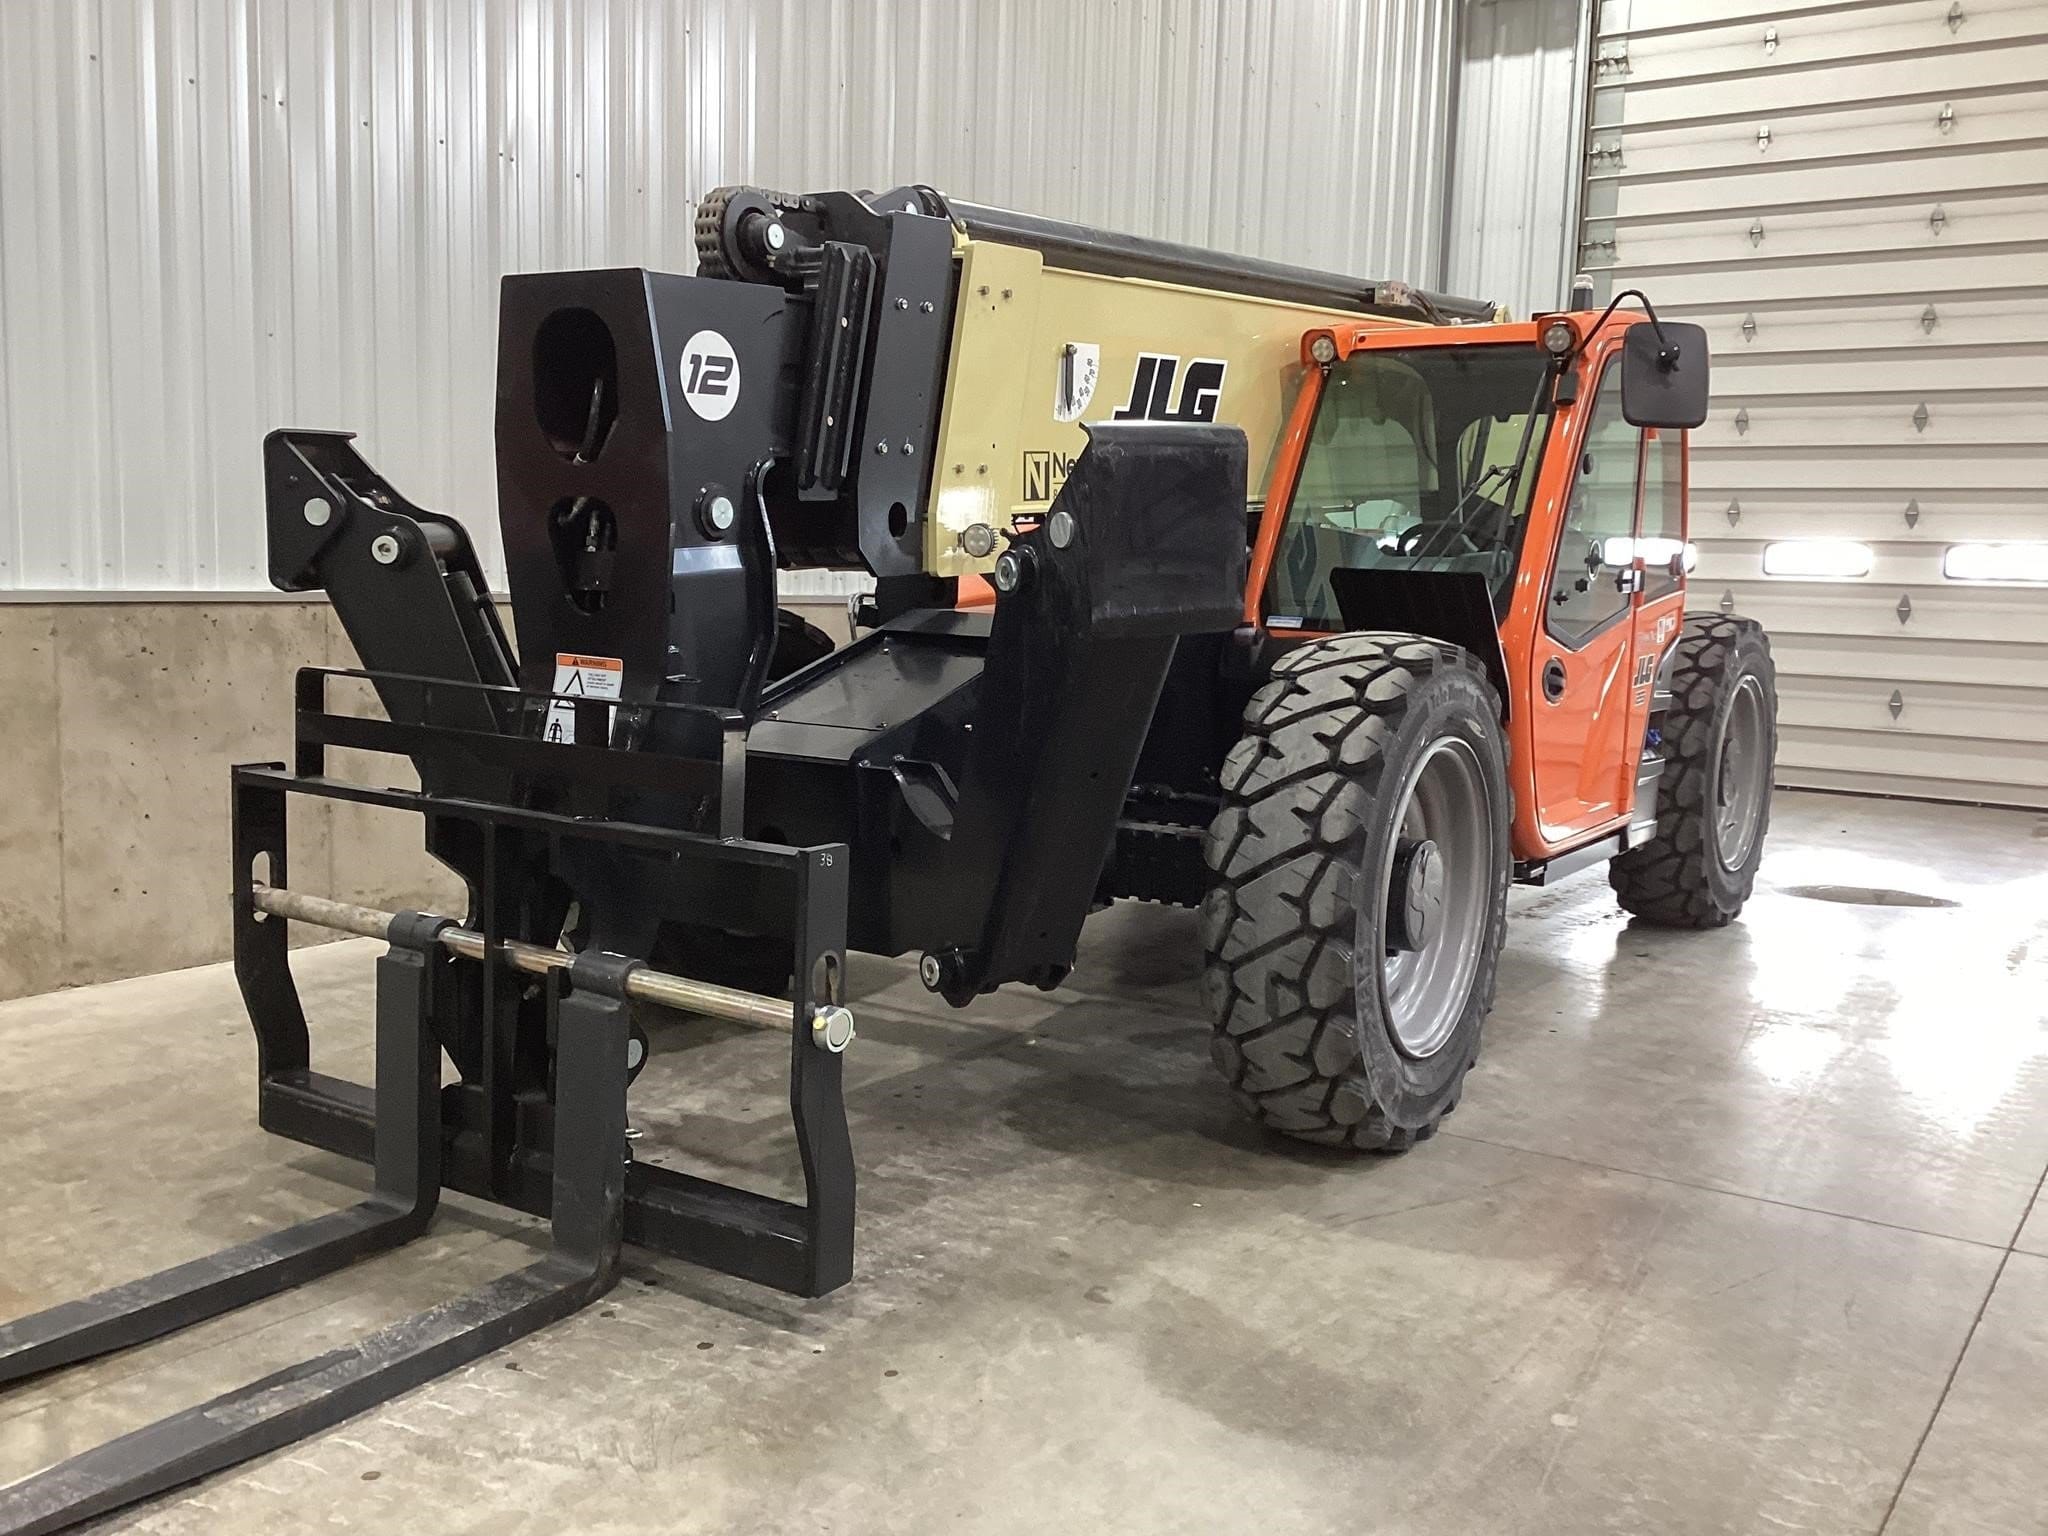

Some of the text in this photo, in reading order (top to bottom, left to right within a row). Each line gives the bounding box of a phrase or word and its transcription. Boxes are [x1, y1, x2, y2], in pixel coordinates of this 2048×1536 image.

[686, 353, 734, 396] 12
[1114, 355, 1226, 422] JLG
[1053, 452, 1078, 479] Ne
[580, 659, 608, 668] WARNING
[1633, 654, 1655, 686] JLG
